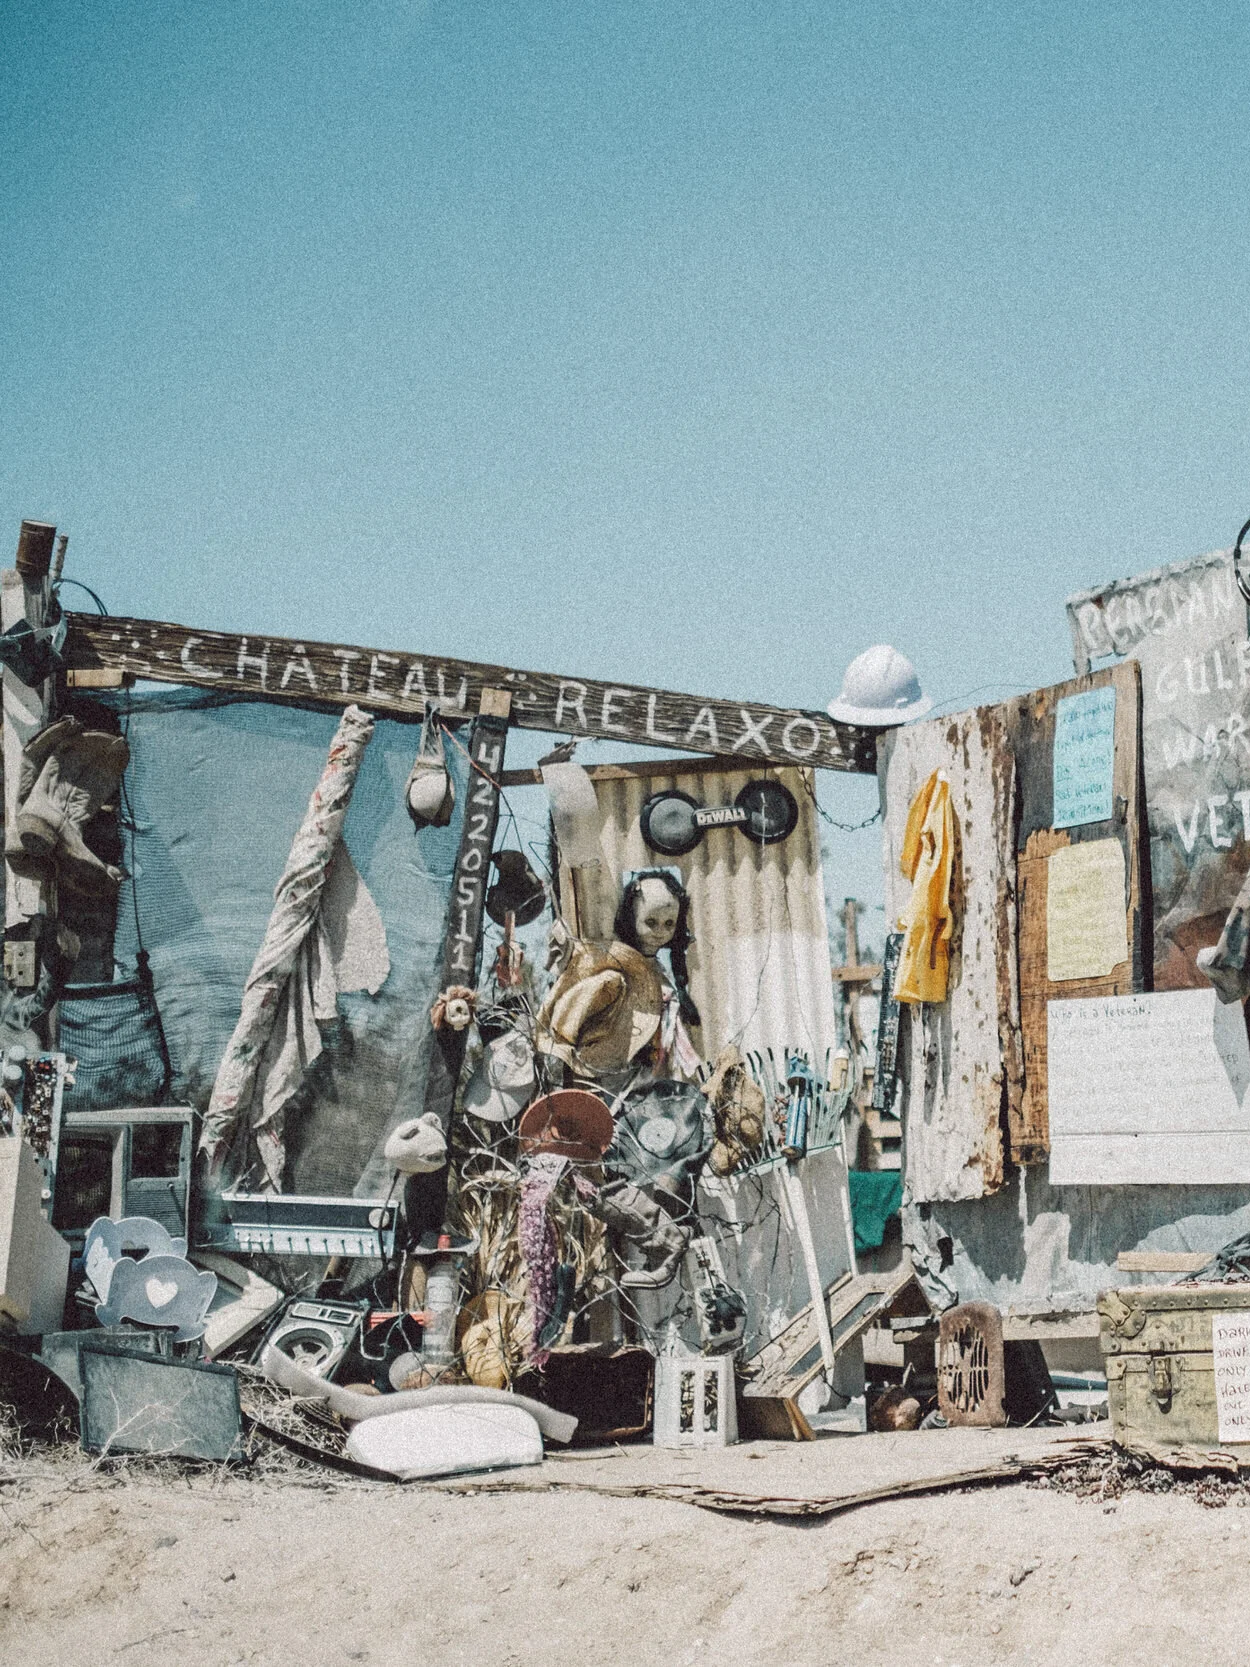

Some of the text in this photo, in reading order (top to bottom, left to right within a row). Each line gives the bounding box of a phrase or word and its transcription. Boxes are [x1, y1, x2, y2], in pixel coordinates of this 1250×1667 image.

[181, 637, 468, 710] CHATEAU
[555, 678, 821, 757] RELAXO
[1163, 712, 1250, 769] WAR
